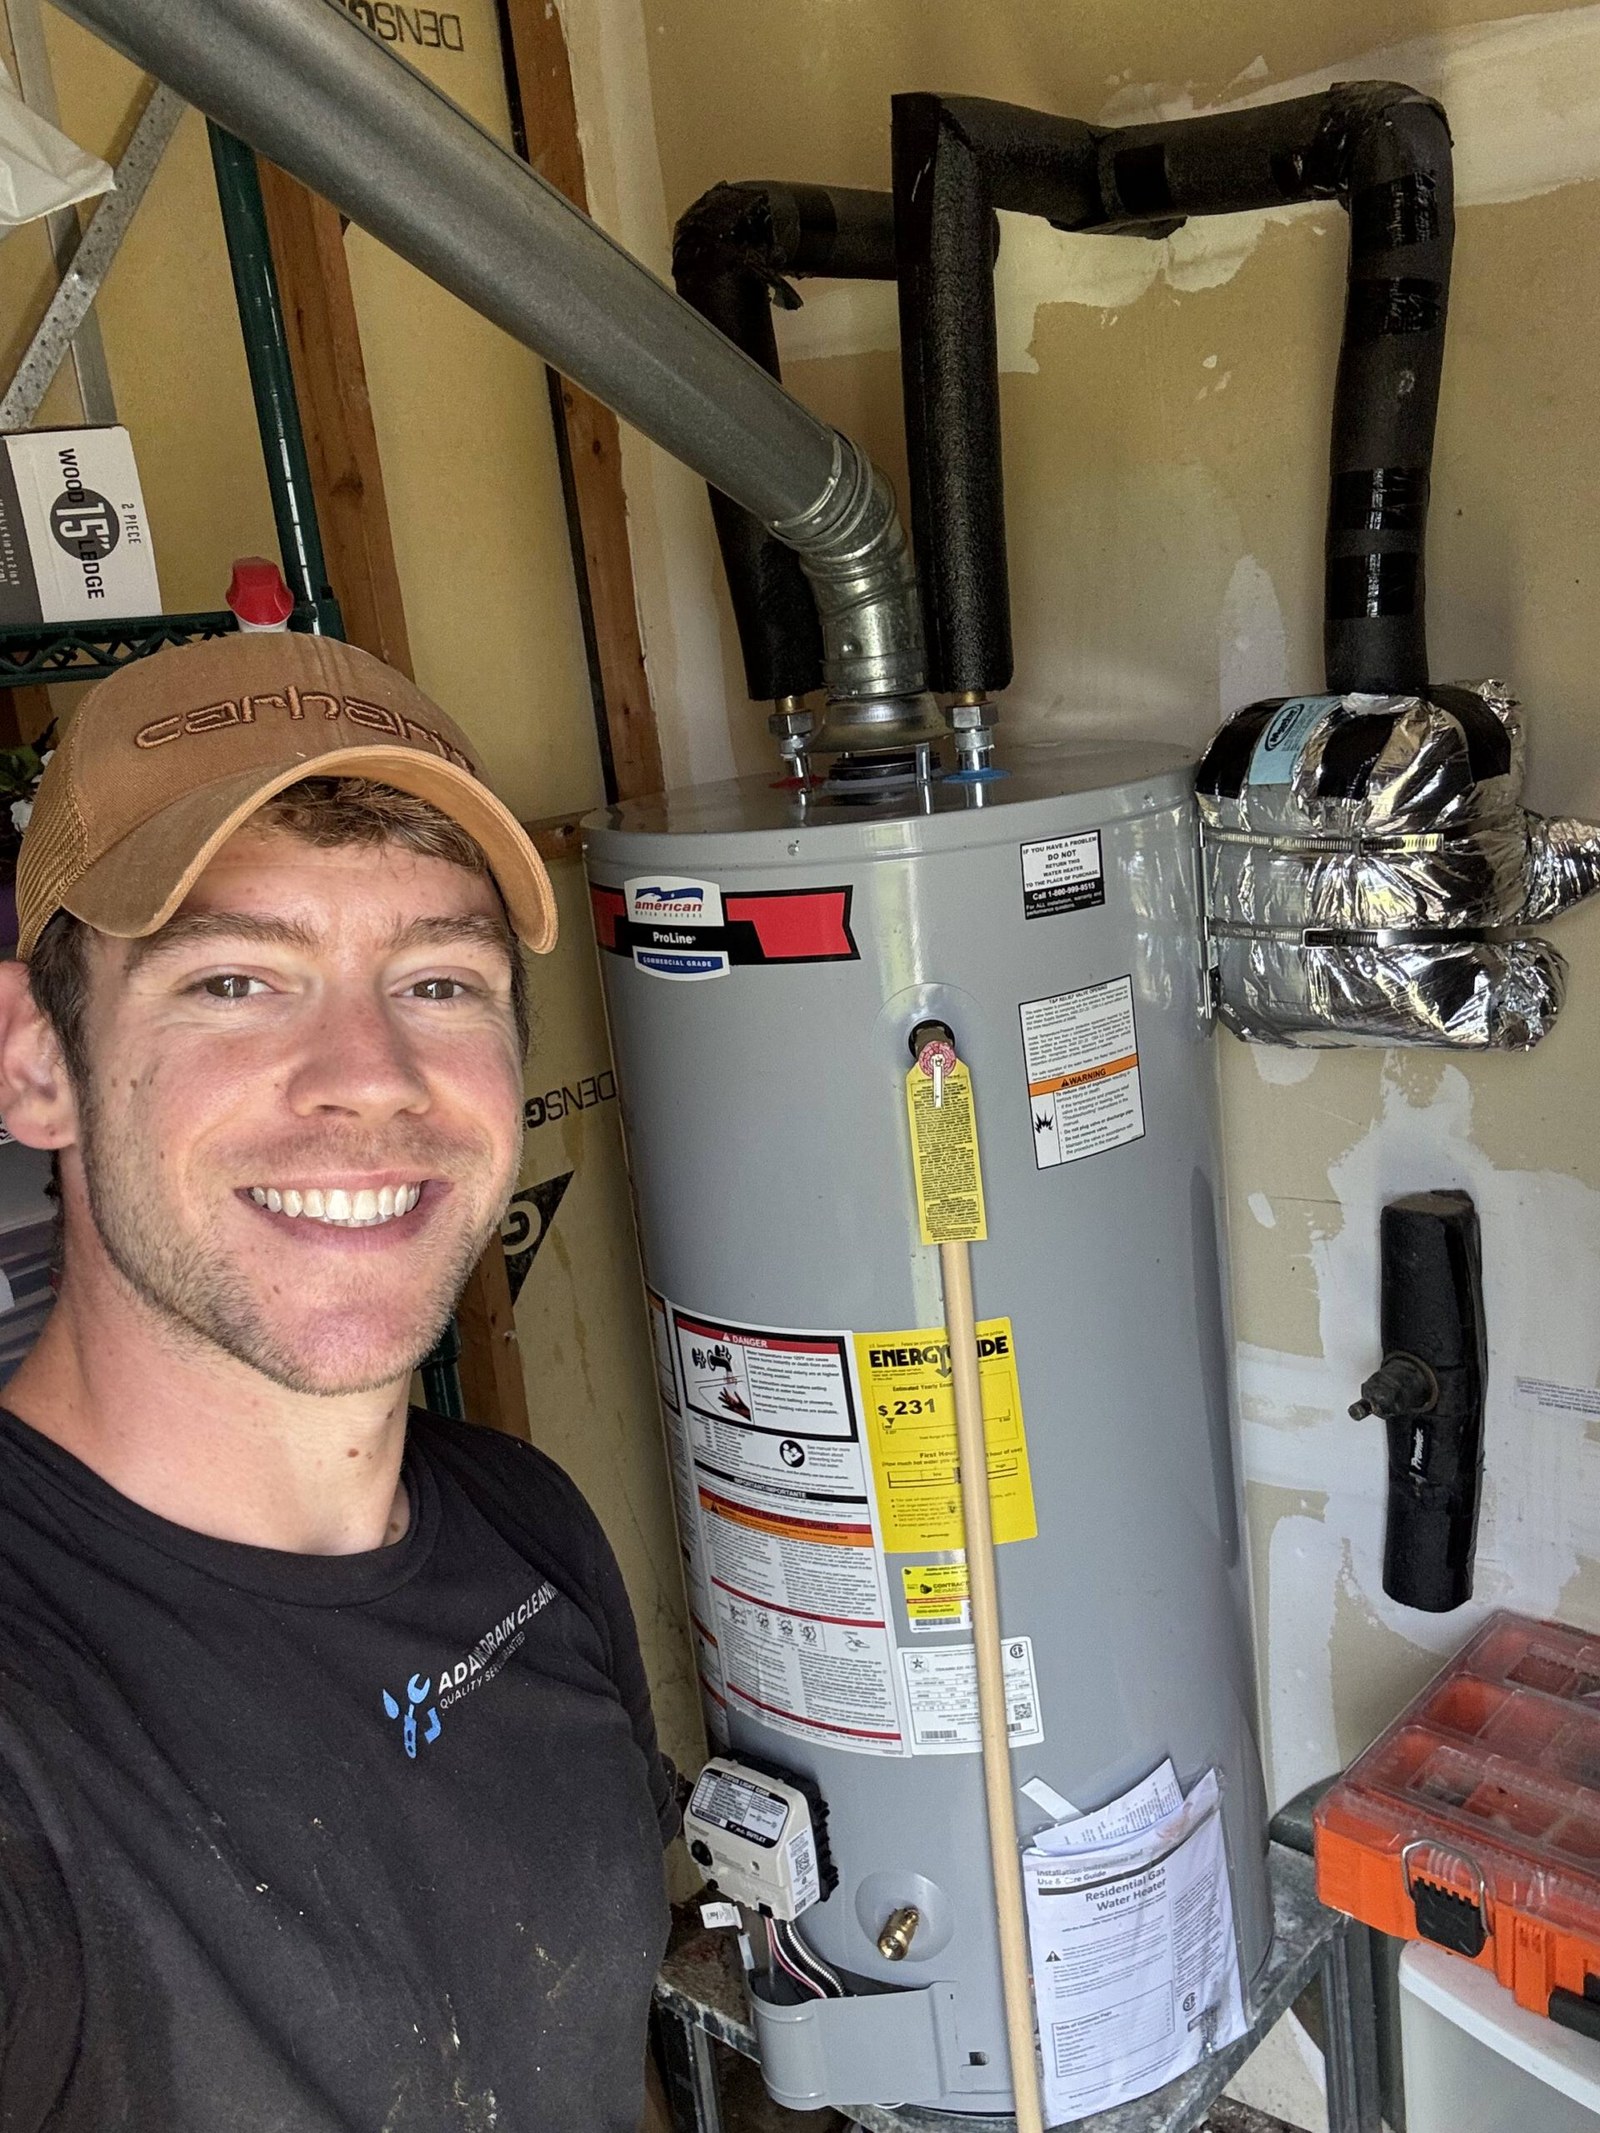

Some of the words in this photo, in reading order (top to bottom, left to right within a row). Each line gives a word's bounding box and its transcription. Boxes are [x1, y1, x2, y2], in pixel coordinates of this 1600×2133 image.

[340, 0, 463, 51] DENSG
[59, 448, 85, 503] WOOD
[124, 514, 141, 544] PIECE
[78, 540, 105, 599] LEDGE
[1031, 846, 1045, 854] YOU
[1046, 843, 1063, 852] HAVE
[1070, 836, 1097, 847] PROBLEM
[1045, 861, 1067, 869] RETURN
[1068, 858, 1081, 866] THIS
[1047, 853, 1059, 861] DO
[1061, 849, 1077, 859] NOT
[1043, 869, 1062, 877] WATER
[1063, 865, 1083, 874] HEATER
[1035, 879, 1045, 887] THE
[1047, 876, 1063, 885] PLACE
[1032, 890, 1047, 900] Call
[635, 900, 702, 912] american
[643, 956, 684, 966] COMMERCIAL
[686, 959, 712, 967] GRADE
[1068, 1069, 1107, 1085] WARNING
[524, 1070, 617, 1129] DENSG
[732, 1335, 769, 1348] DANGER
[878, 1404, 888, 1417] $
[893, 1398, 936, 1416] 231
[933, 1581, 970, 1589] CONTRACT
[438, 1646, 490, 1695] ADAM
[479, 1612, 516, 1655] DRAIN
[517, 1580, 559, 1625] CLEAN
[440, 1676, 483, 1709] QUALITY
[721, 1772, 740, 1784] STATUS
[739, 1779, 755, 1792] LIGHT
[755, 1785, 771, 1797] CODE
[1037, 1865, 1083, 1877] Installation
[1083, 1856, 1129, 1872] Instructions
[1129, 1849, 1144, 1861] and
[1037, 1878, 1053, 1886] Use
[1083, 1870, 1107, 1882] Guide
[1085, 1875, 1147, 1902] Residential
[1148, 1866, 1166, 1882] Gas
[1096, 1893, 1130, 1912] Water
[1132, 1878, 1167, 1900] Heater
